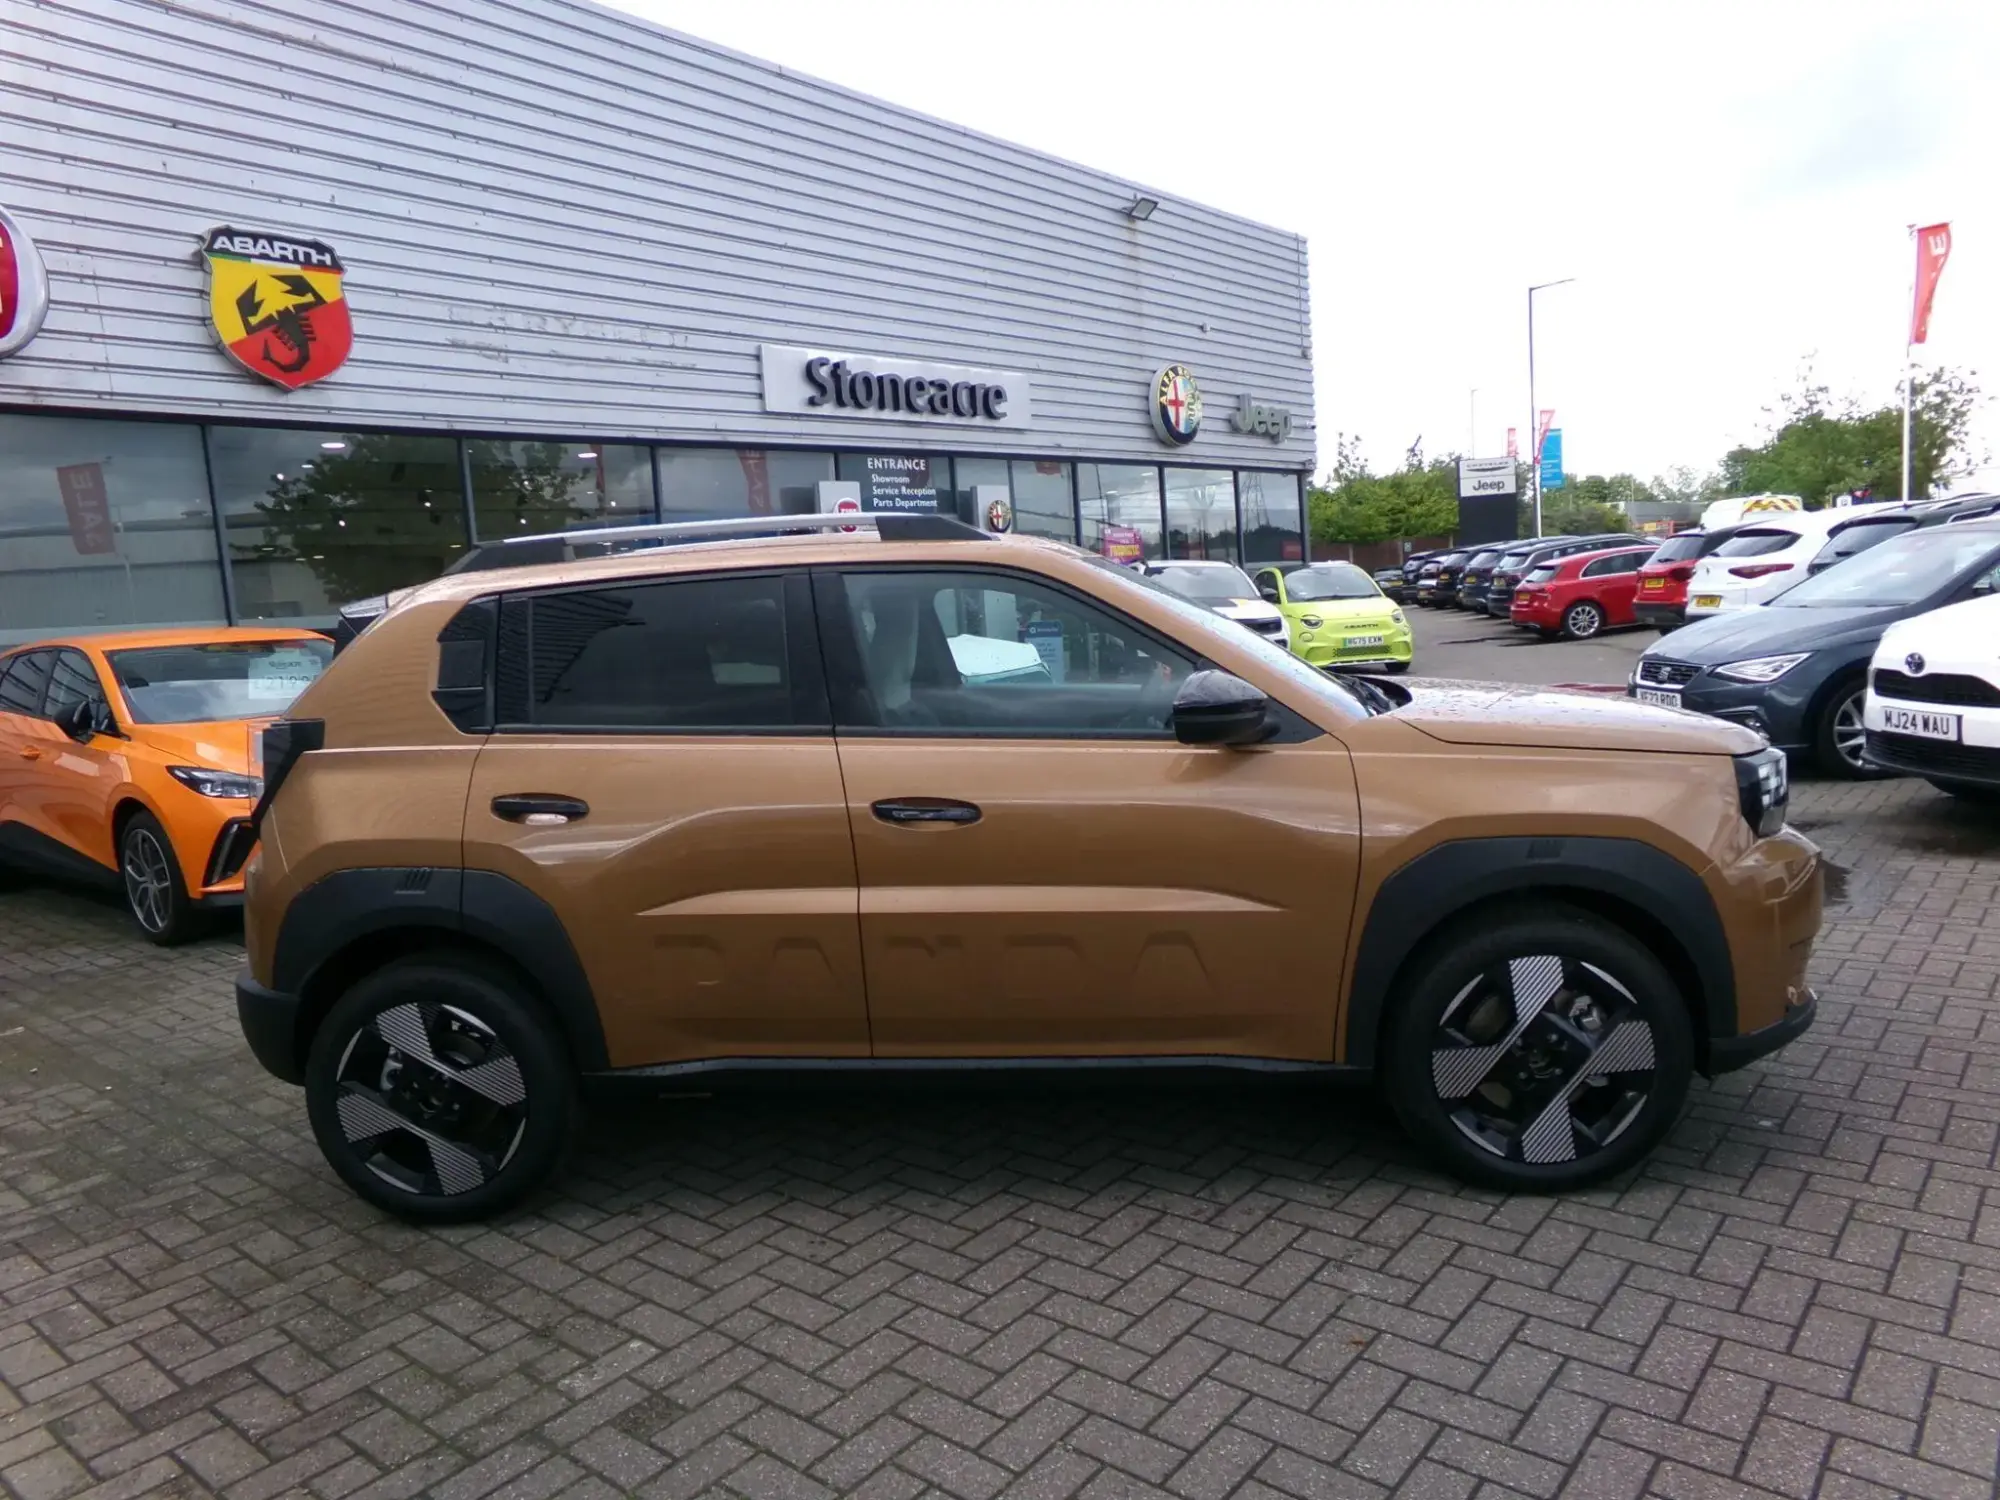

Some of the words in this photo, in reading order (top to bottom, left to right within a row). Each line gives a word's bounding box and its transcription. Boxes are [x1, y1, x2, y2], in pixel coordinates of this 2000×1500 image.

[212, 235, 332, 266] ABARTH
[806, 356, 1008, 419] Stoneacre
[1231, 393, 1292, 442] Jeep
[867, 457, 926, 471] ENTRANCE
[872, 473, 910, 484] Showroom
[872, 486, 899, 495] Service
[901, 486, 936, 497] Reception
[1472, 480, 1505, 492] Jeep
[873, 498, 893, 507] Parts
[895, 498, 938, 509] Department
[1921, 714, 1950, 735] WAU
